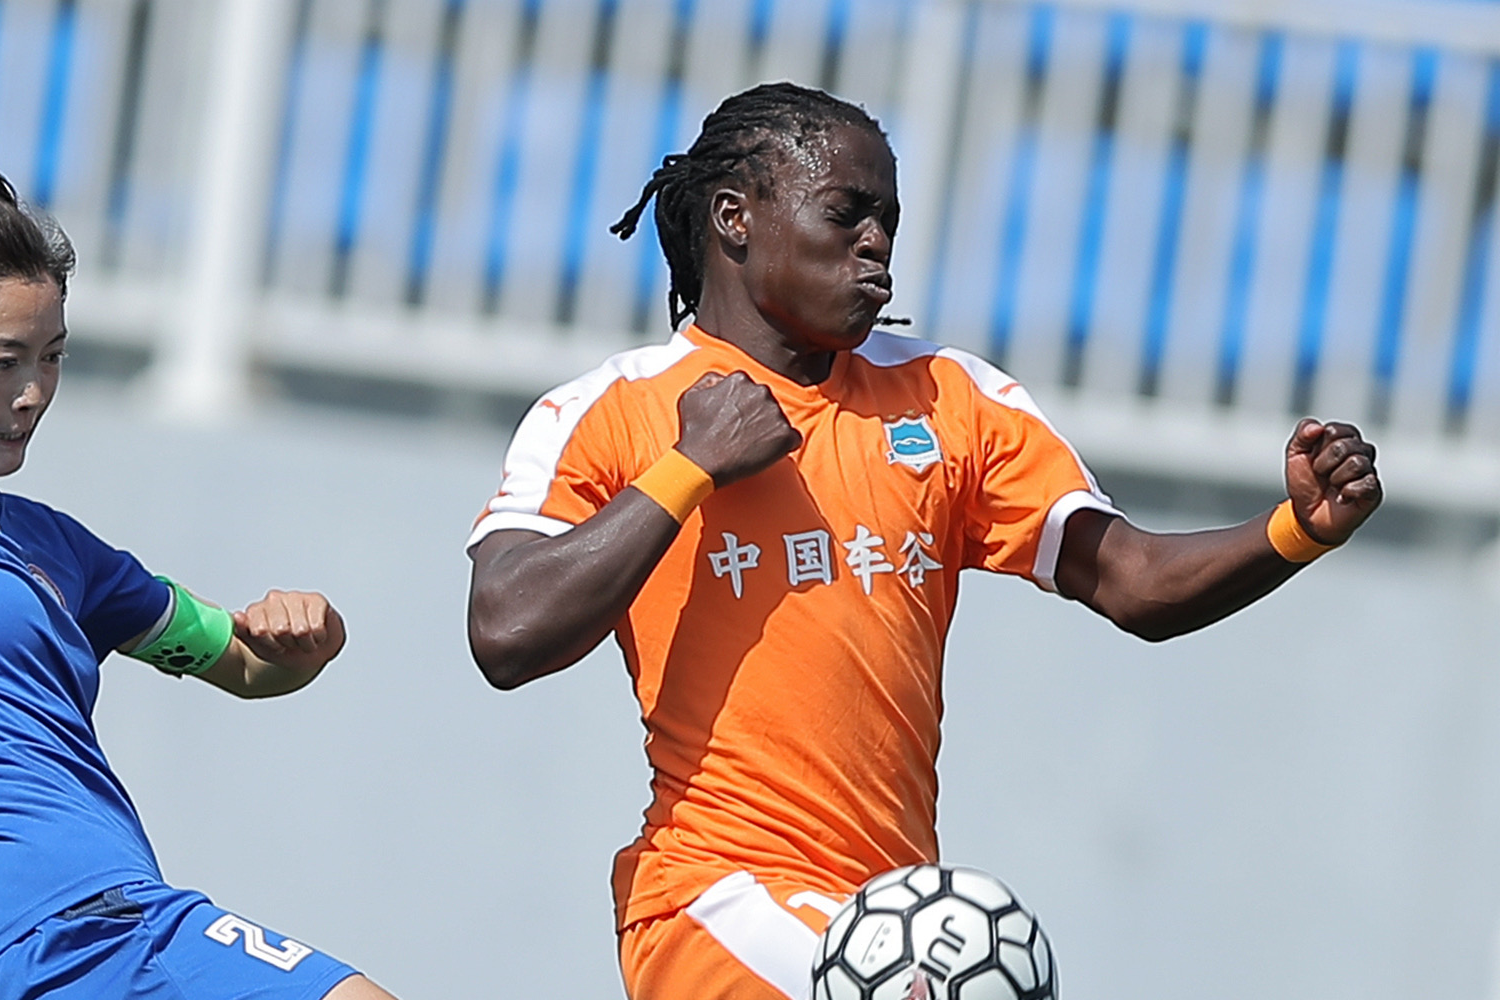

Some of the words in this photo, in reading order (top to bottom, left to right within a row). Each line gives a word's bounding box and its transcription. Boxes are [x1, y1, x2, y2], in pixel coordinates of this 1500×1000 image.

[707, 525, 943, 599] 中国车谷
[203, 912, 315, 973] 2
